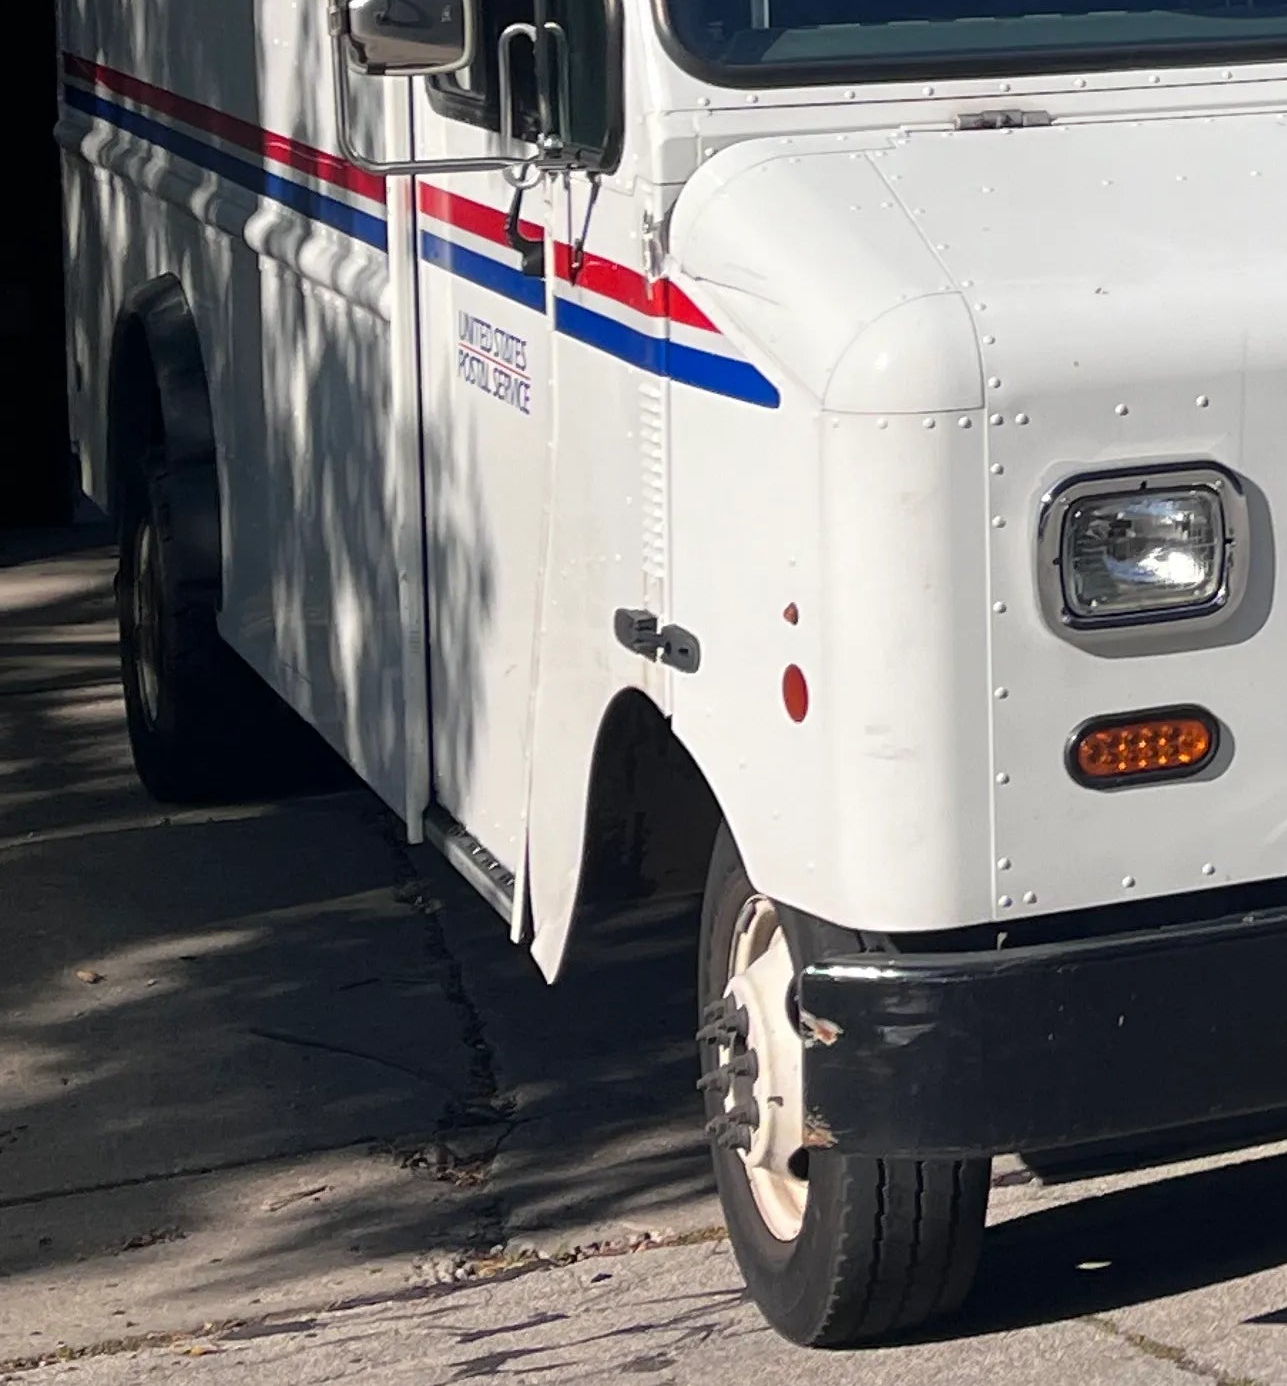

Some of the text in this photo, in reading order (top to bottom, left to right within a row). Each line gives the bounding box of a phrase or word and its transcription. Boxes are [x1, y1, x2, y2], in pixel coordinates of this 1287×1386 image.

[458, 309, 528, 372] UNITED STATES
[457, 349, 531, 415] POSTAL SERVICE
